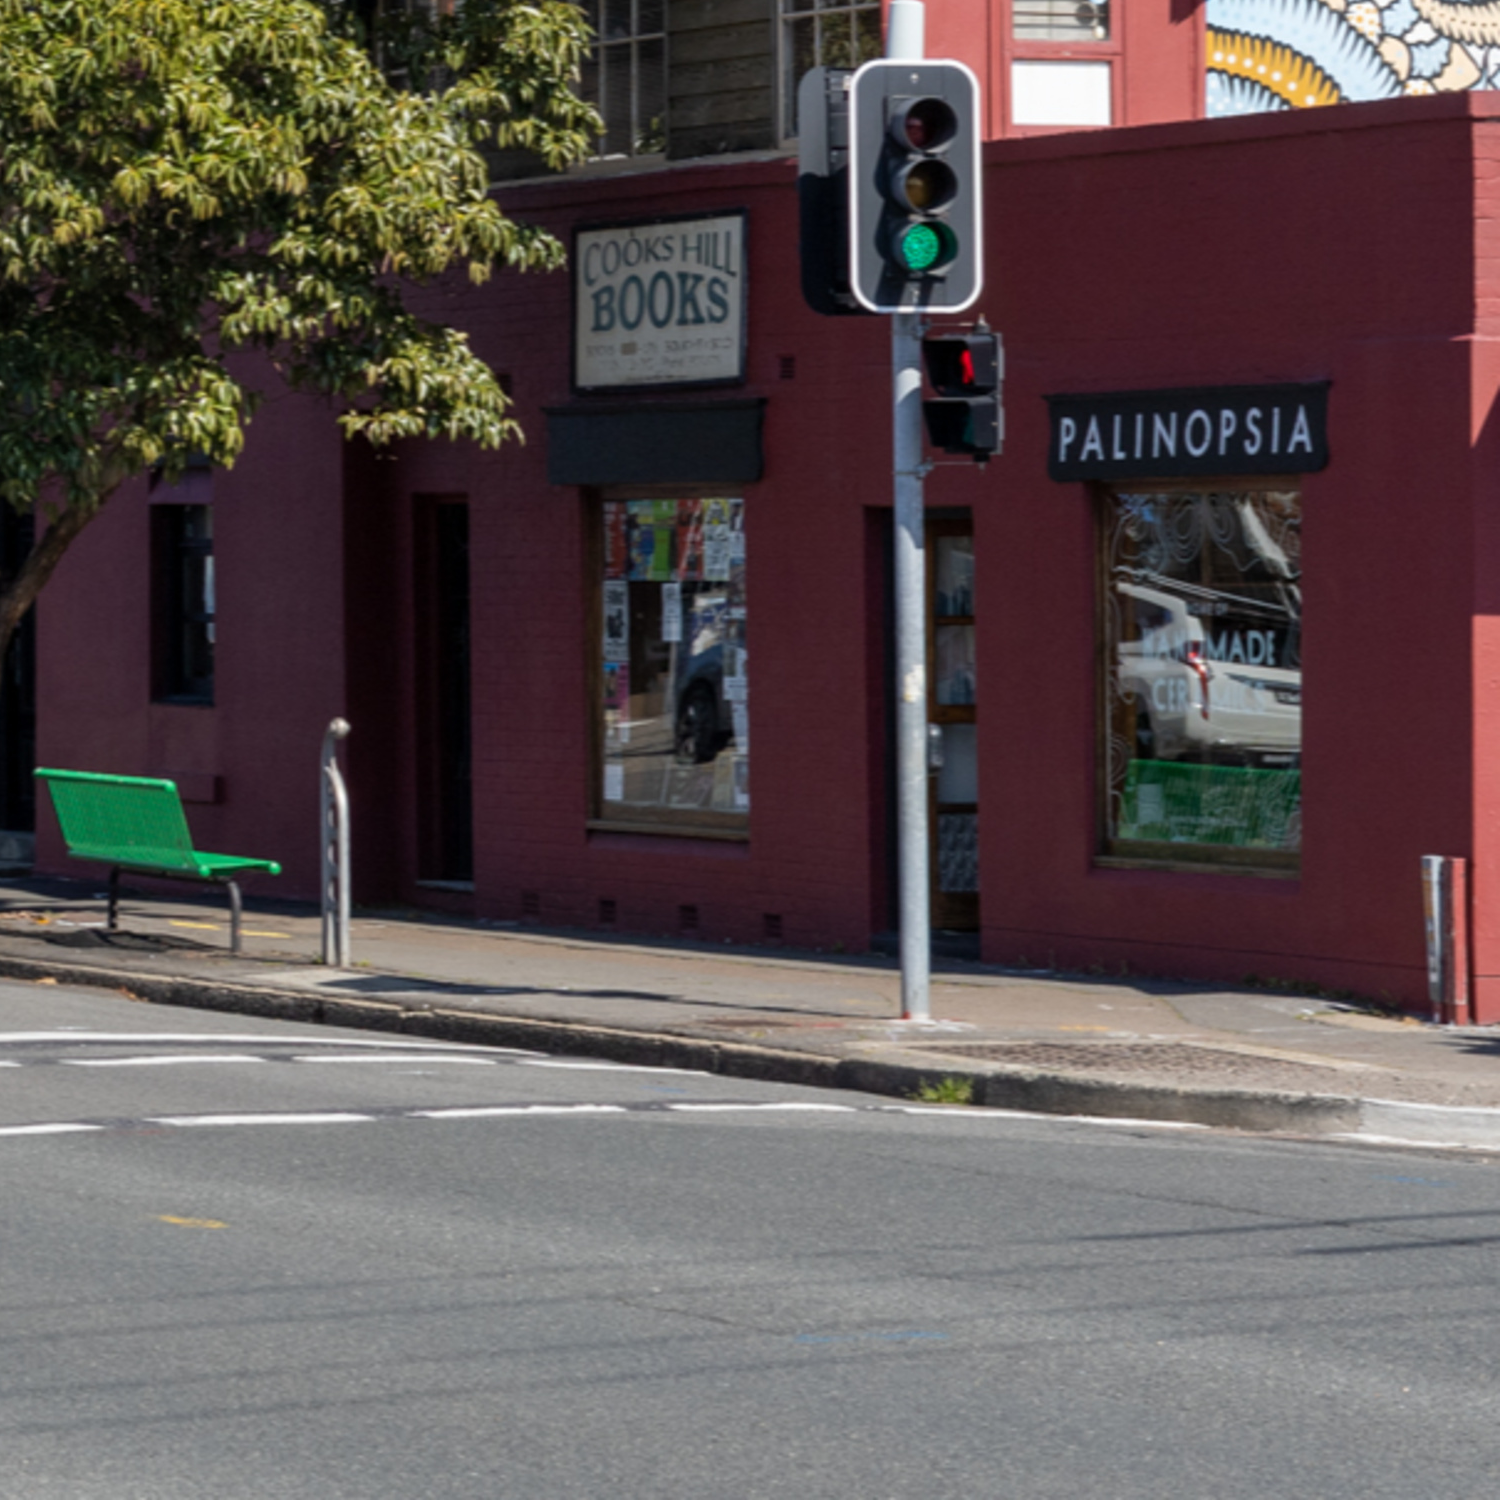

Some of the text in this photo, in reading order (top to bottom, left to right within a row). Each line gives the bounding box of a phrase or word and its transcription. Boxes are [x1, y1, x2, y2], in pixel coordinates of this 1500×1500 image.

[583, 230, 738, 287] COOKS HILL
[591, 269, 730, 333] BOOKS
[1058, 403, 1314, 463] PALINOPSIA
